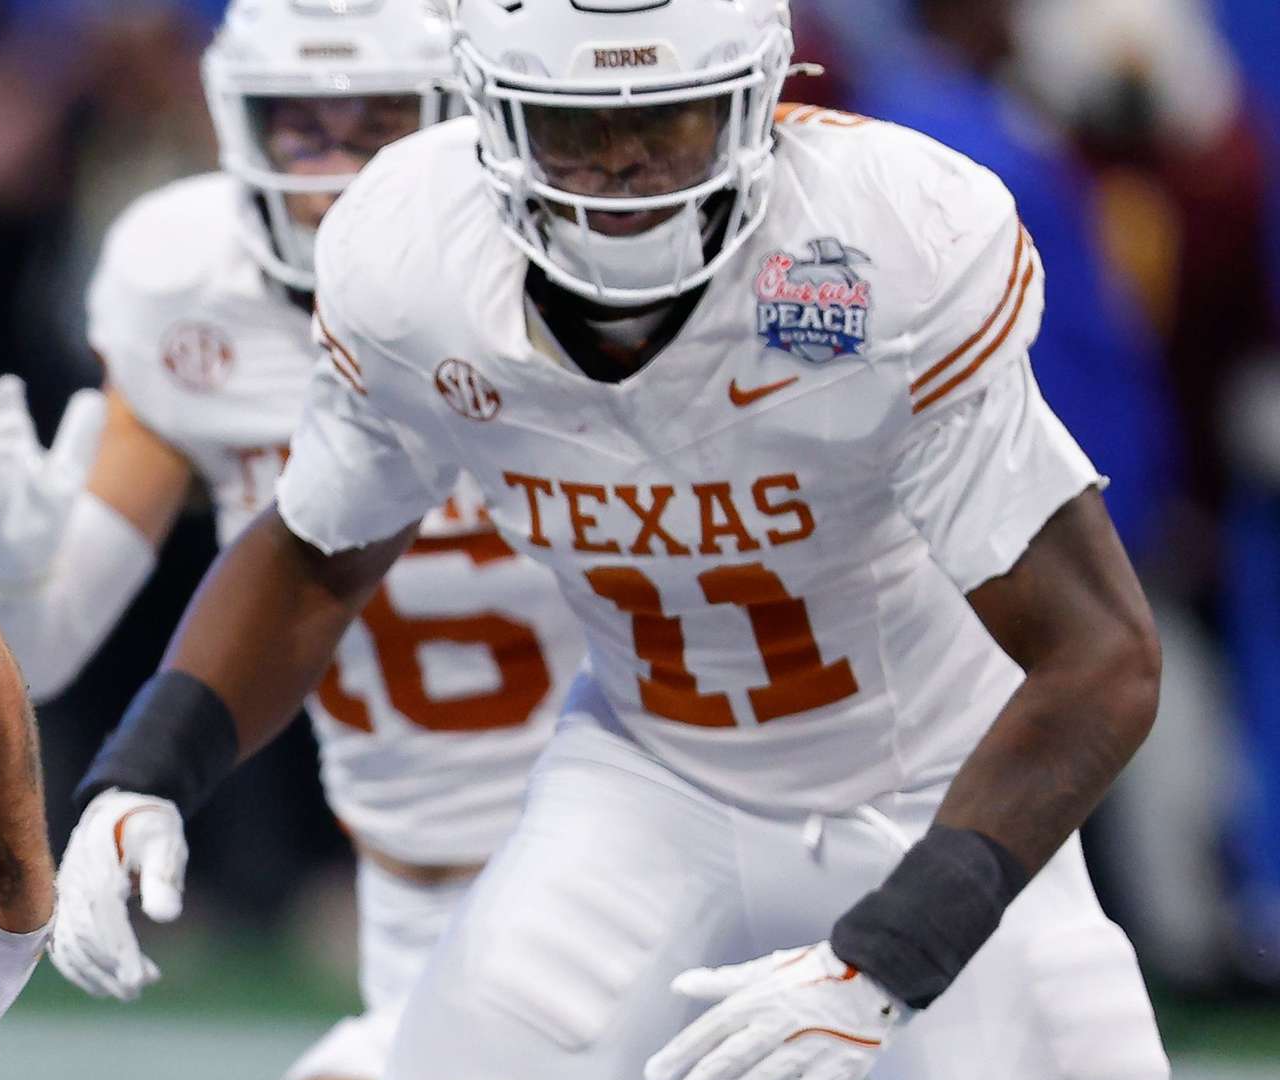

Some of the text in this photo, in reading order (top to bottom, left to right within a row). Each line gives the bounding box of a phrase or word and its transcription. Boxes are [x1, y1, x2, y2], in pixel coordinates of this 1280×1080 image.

[594, 46, 657, 68] HORNS
[758, 303, 867, 340] PEACH
[503, 471, 815, 556] TEXAS
[583, 562, 860, 728] 11
